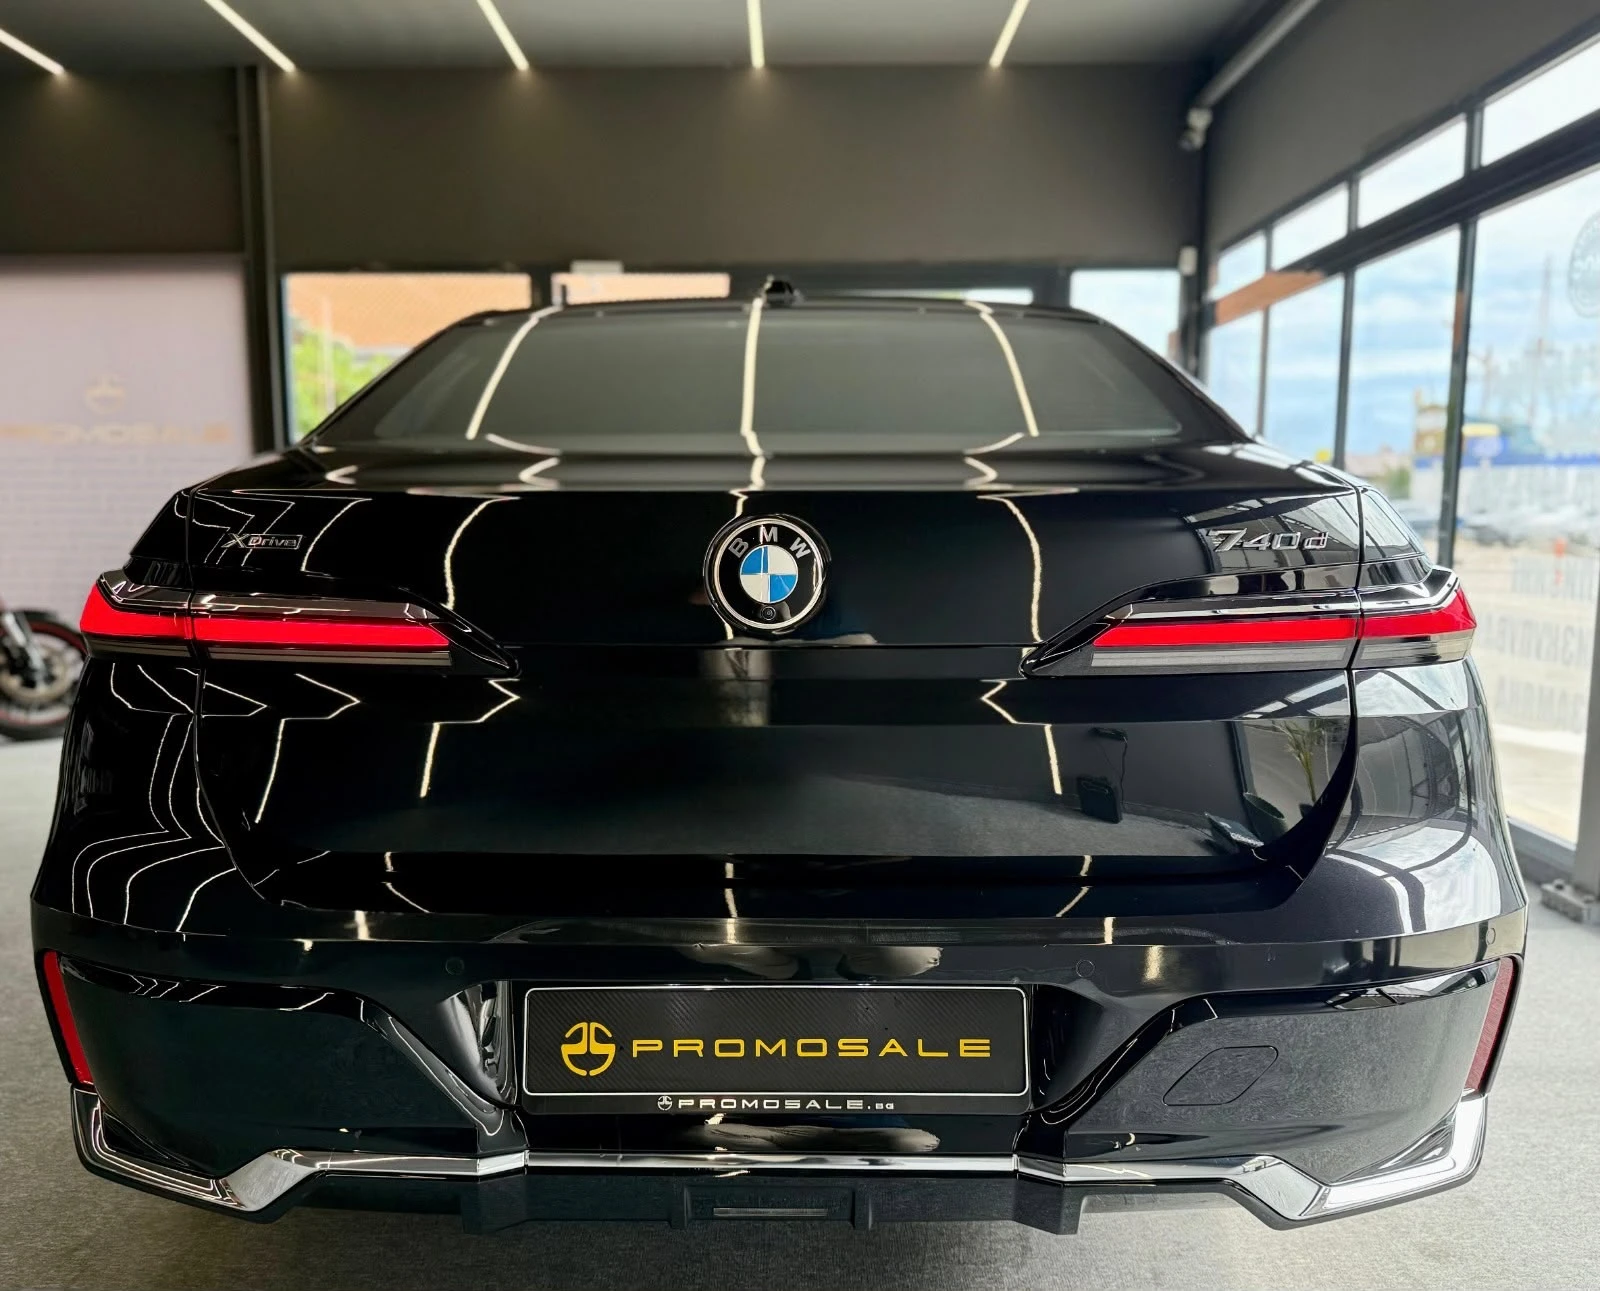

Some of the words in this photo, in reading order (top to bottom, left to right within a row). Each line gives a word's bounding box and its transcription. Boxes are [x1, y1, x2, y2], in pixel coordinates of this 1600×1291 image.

[728, 524, 812, 559] BMW
[1208, 527, 1329, 553] 740d
[632, 1037, 991, 1058] PROMOSALE
